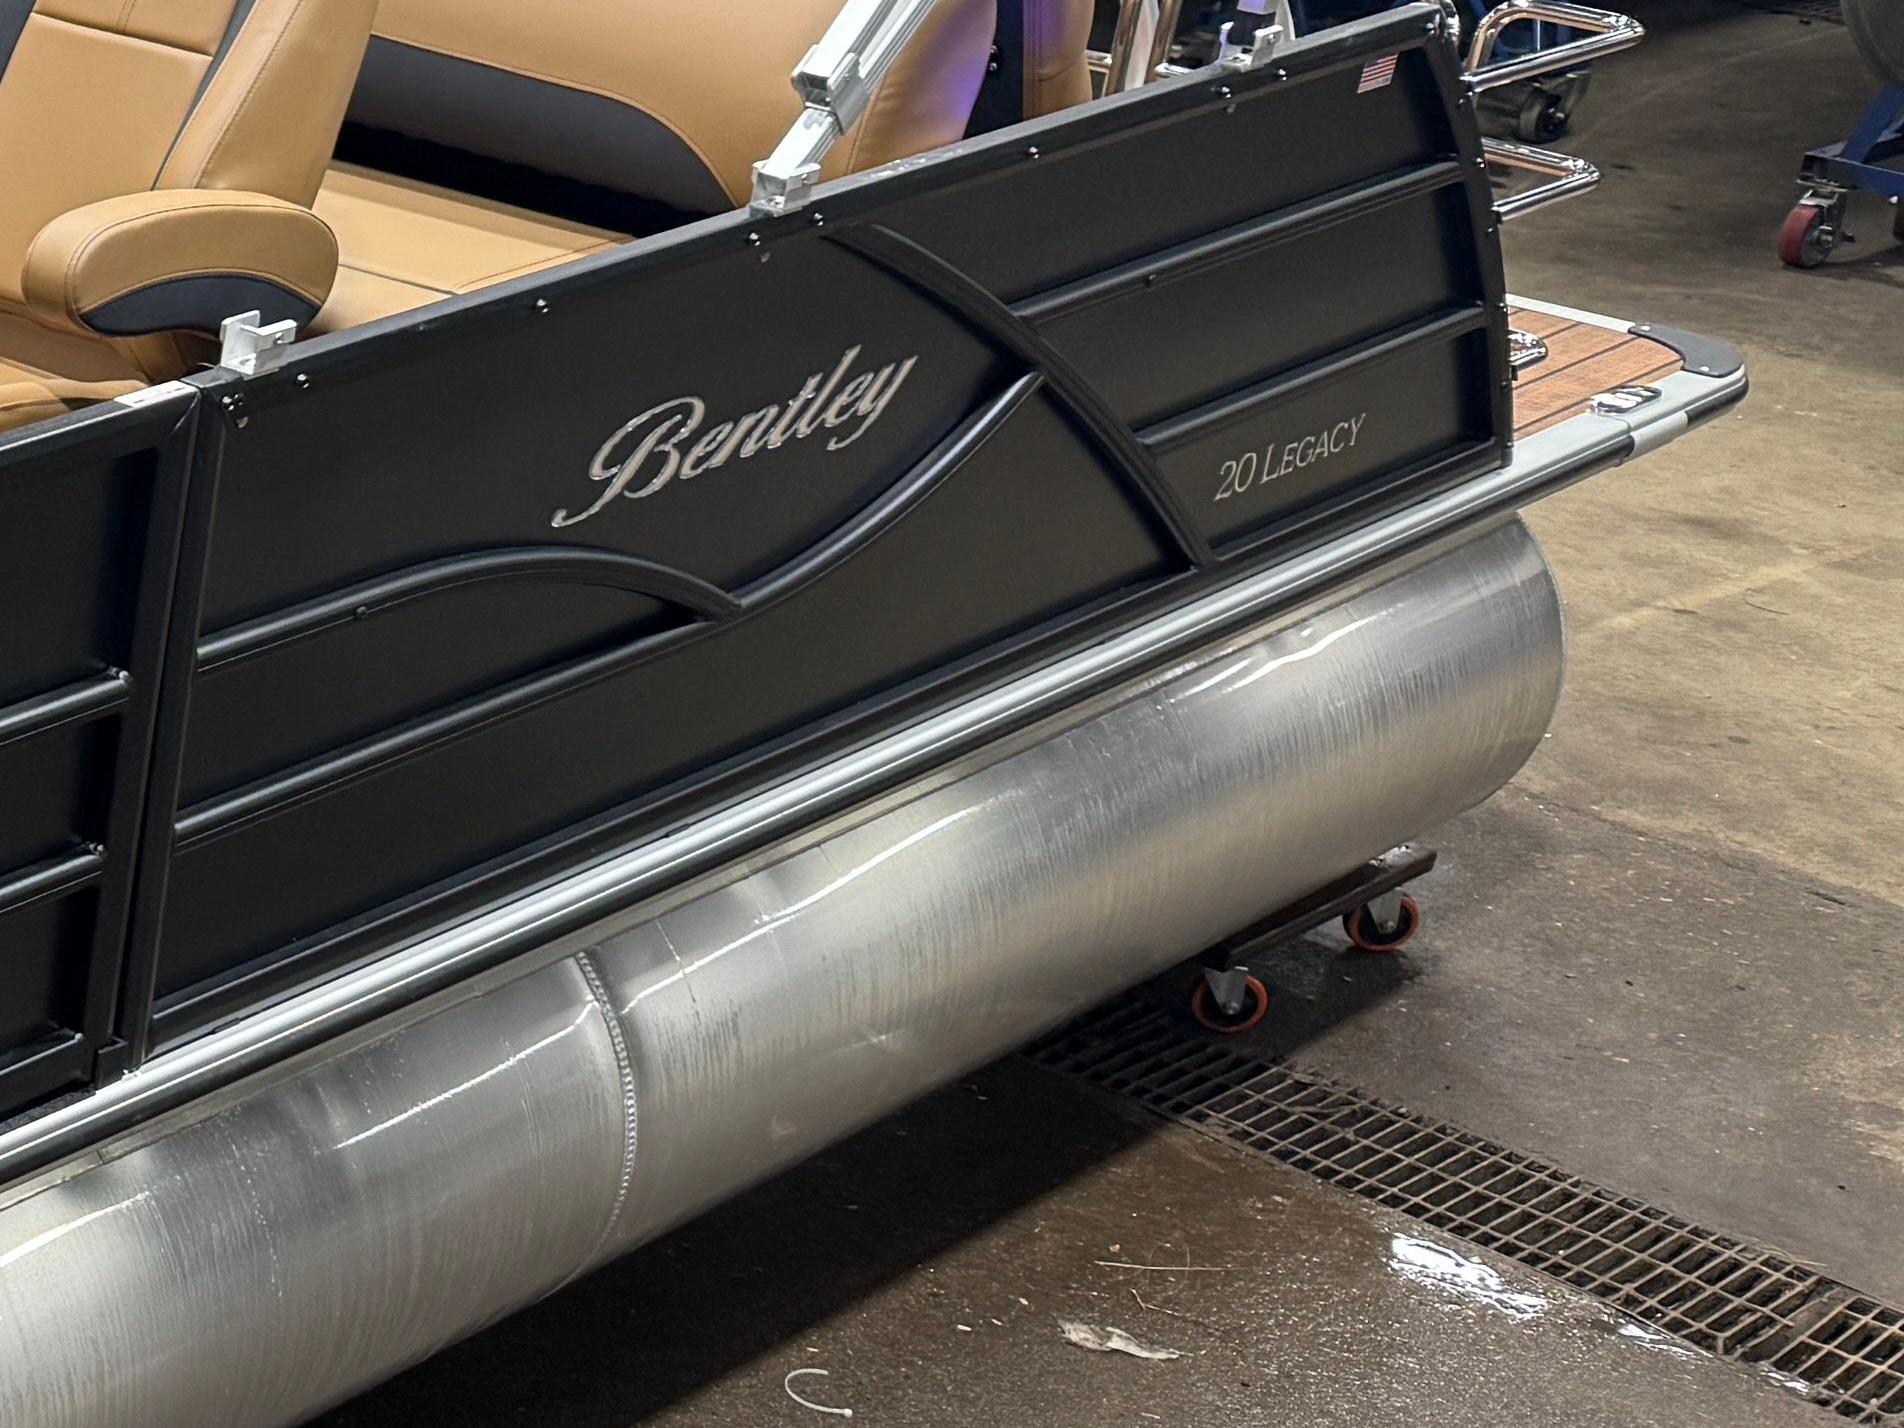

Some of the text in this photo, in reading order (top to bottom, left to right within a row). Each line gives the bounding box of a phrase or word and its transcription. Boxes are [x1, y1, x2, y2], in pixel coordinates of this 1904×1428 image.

[551, 344, 919, 528] Bentley
[1214, 412, 1367, 502] 20 LEGACY
